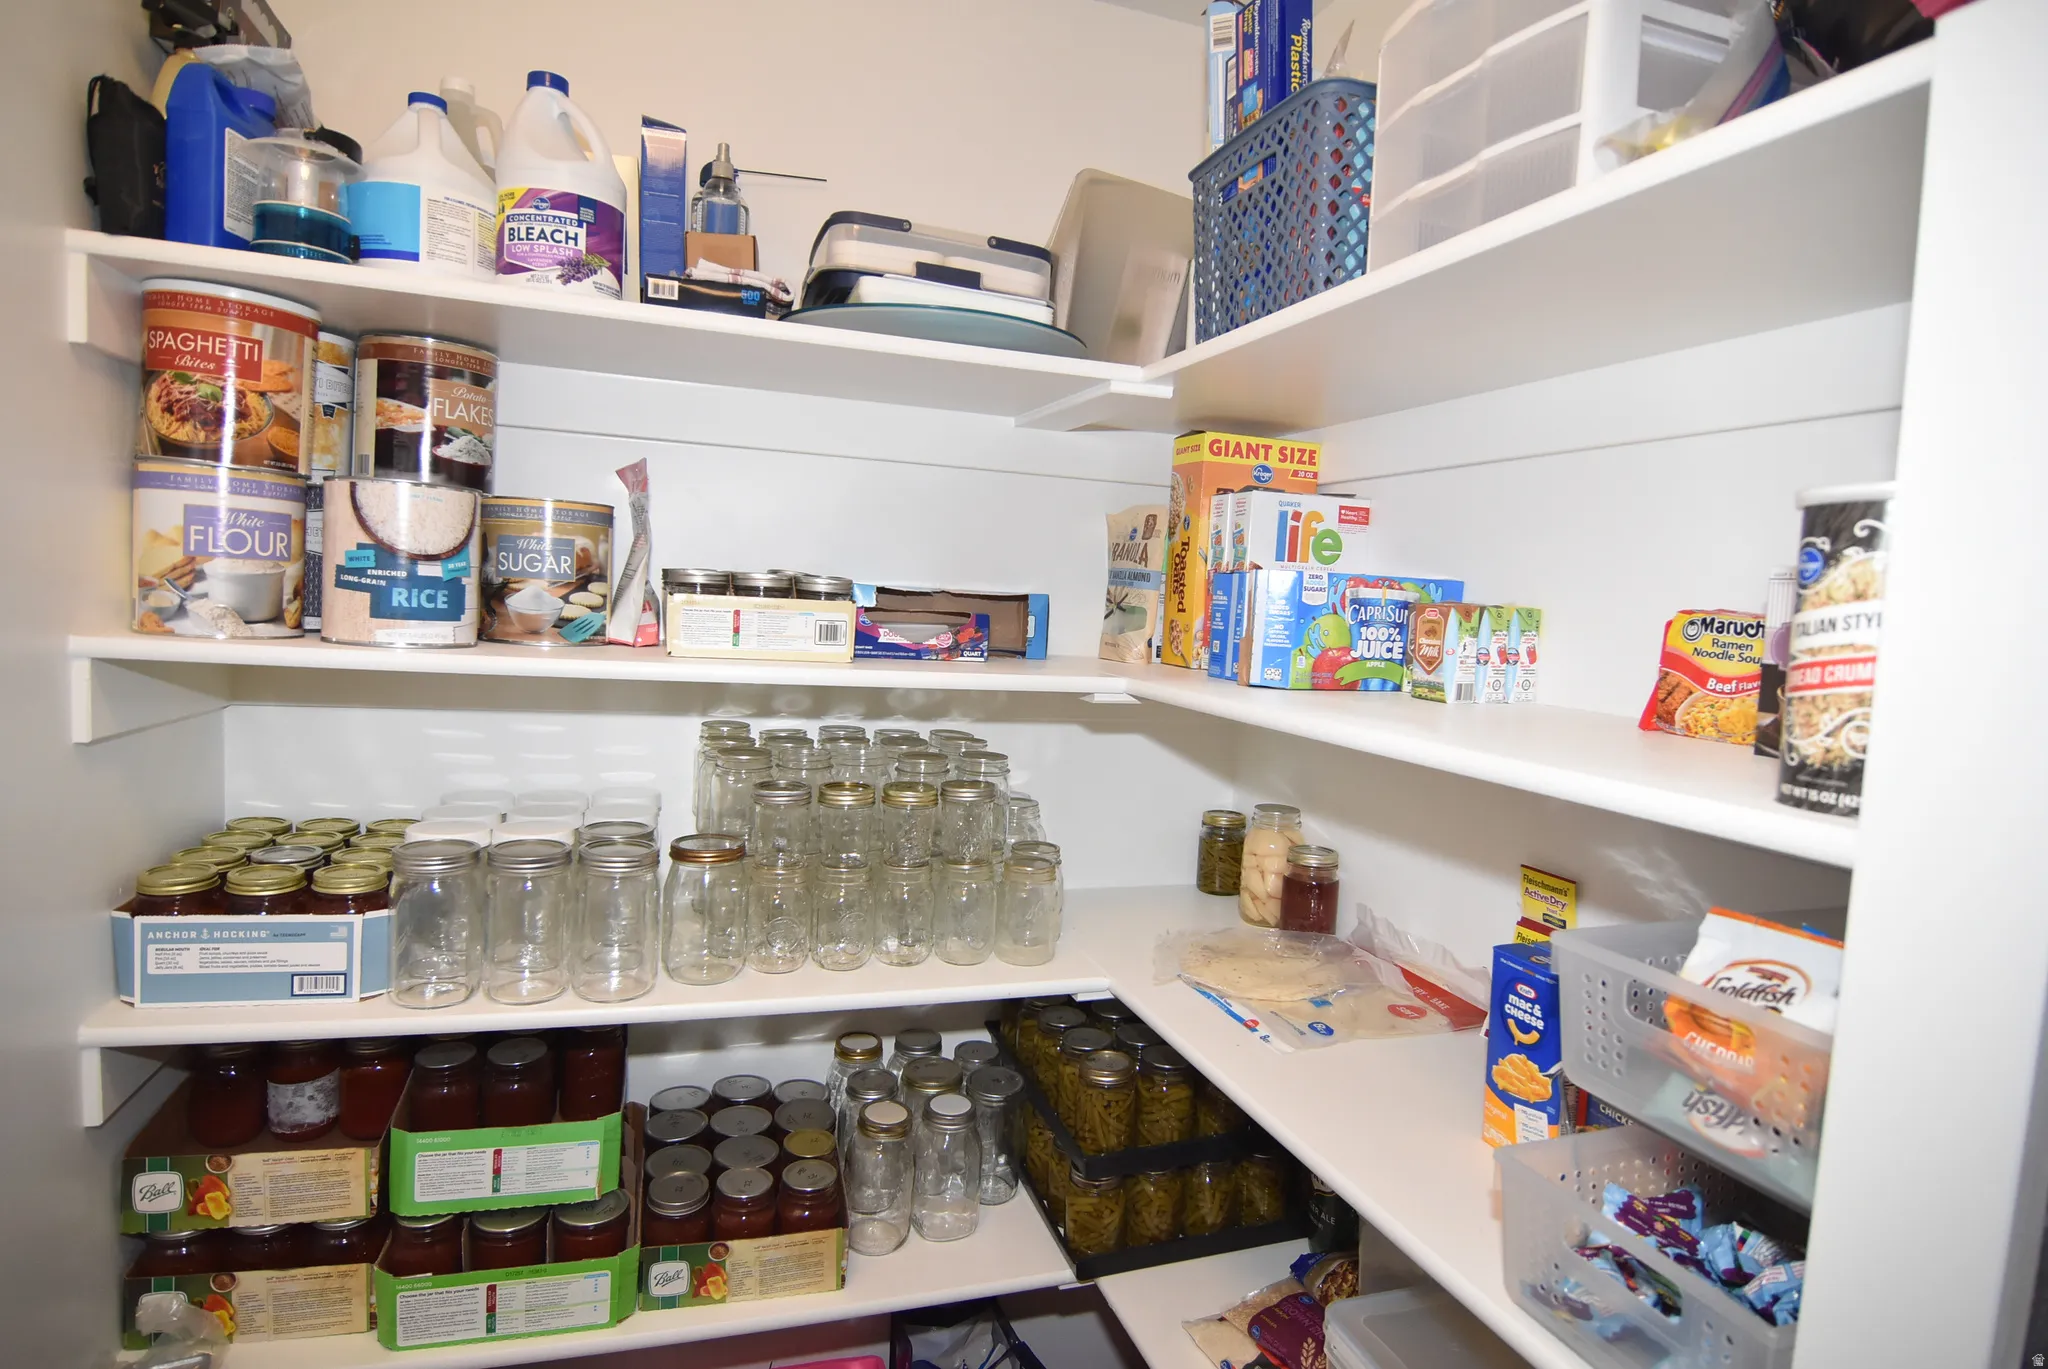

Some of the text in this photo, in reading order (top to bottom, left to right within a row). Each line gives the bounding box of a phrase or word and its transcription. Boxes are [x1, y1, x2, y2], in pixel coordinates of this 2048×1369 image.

[1301, 18, 1311, 64] Reynolds
[1290, 34, 1302, 92] Plastic
[509, 214, 578, 226] CONCENTRATED
[508, 226, 578, 247] BLEACH
[511, 244, 573, 257] LOW SPLASH
[741, 289, 760, 300] 500
[219, 300, 275, 317] STORAGE
[148, 330, 259, 362] SPAGHETTI
[174, 353, 217, 371] Bites
[451, 386, 487, 402] Potato
[433, 397, 494, 427] FLAKES
[1175, 444, 1202, 456] GIANT SIZE
[1208, 438, 1317, 466] GIANT SIZE
[1253, 467, 1272, 481] Kroger
[1278, 499, 1301, 508] QUAKER
[219, 511, 265, 528] White
[190, 525, 288, 558] FLOUR
[516, 538, 553, 551] White
[1275, 509, 1343, 566] life
[348, 554, 371, 563] WHITE
[498, 551, 572, 574] SUGAR
[1111, 542, 1149, 568] RANOLA
[340, 573, 387, 587] LONG-GRAIN
[367, 568, 408, 578] ENRICHED
[1127, 571, 1151, 583] ALMOND
[1177, 536, 1191, 613] Toasted
[391, 587, 449, 609] RICE
[1360, 626, 1401, 641] 100%
[1700, 616, 1765, 639] Maruch
[1795, 611, 1883, 638] TALIAN STYL
[1350, 639, 1404, 659] JUICE
[1419, 644, 1440, 658] Milk
[1711, 638, 1754, 652] Ramen
[1692, 647, 1762, 665] Noodle Sou
[1792, 661, 1875, 686] EAD CRUM
[1706, 677, 1761, 693] Beef Flav
[1523, 873, 1568, 897] Fleischmann's
[1524, 886, 1568, 912] Active Dry
[147, 930, 268, 940] ANCHOR HOCKING
[1413, 986, 1428, 997] FRY
[1519, 985, 1533, 996] Kraft
[1508, 993, 1543, 1018] mac &
[1599, 1103, 1633, 1126] CHICKE
[139, 1180, 177, 1202] Ball
[1320, 1212, 1336, 1226] ALE
[653, 1268, 684, 1288] Ball
